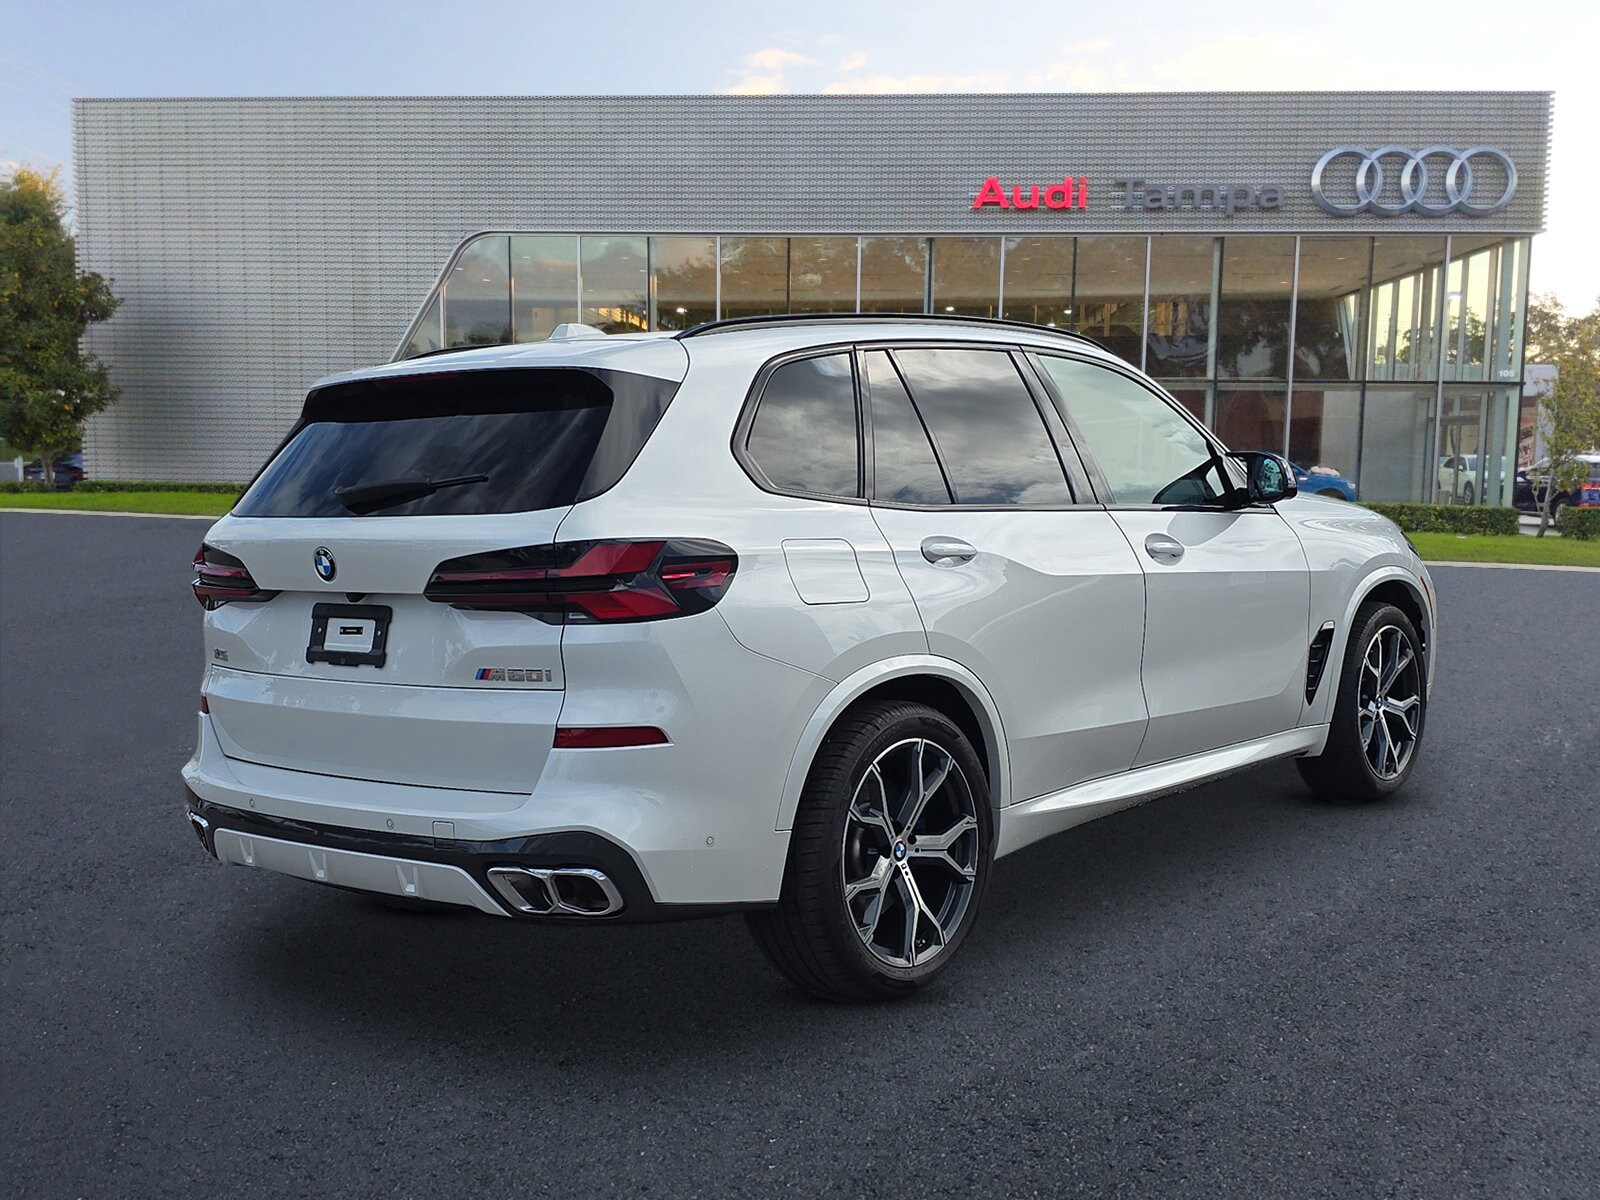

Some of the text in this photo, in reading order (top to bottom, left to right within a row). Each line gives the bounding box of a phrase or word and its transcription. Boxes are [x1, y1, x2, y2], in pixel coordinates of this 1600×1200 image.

[972, 177, 1285, 217] Audi Tampa
[1499, 369, 1515, 378] 105
